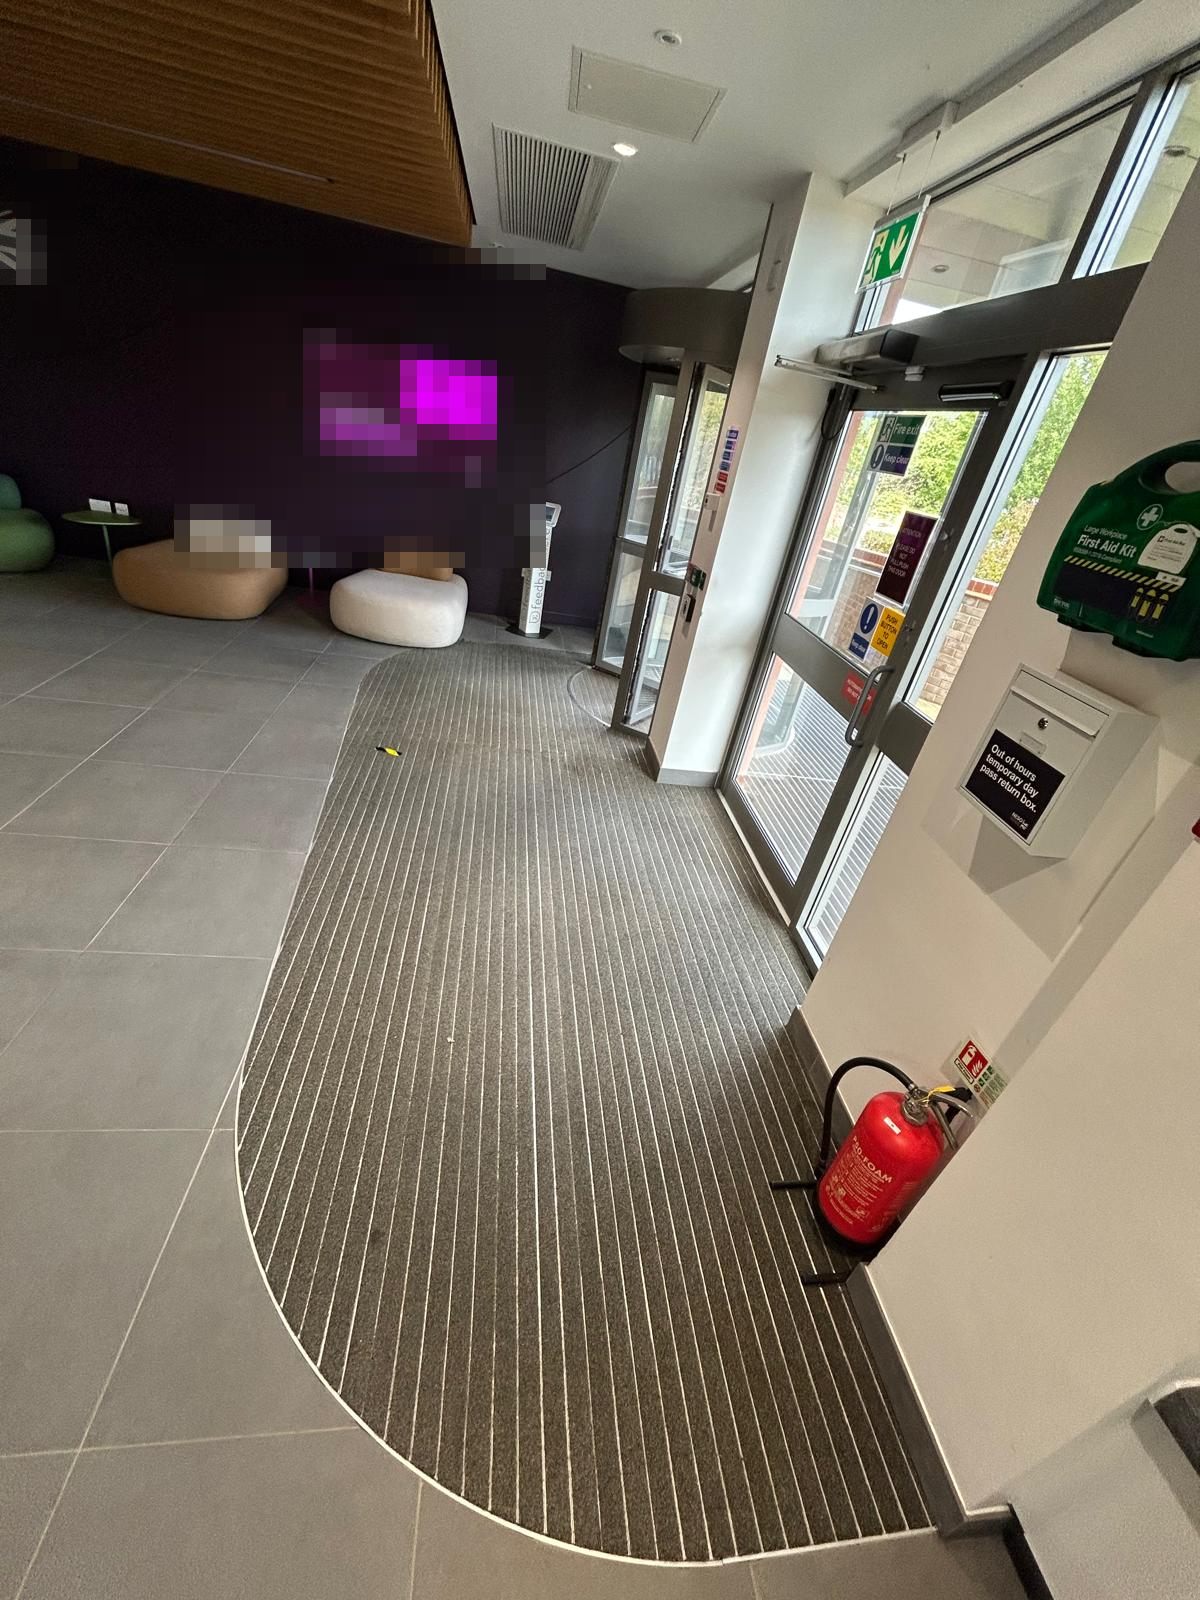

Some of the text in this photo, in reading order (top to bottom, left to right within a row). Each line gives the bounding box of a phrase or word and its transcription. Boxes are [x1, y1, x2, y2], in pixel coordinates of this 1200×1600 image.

[894, 421, 920, 434] Fire exit
[884, 455, 896, 465] Keep
[1077, 534, 1101, 549] First
[1099, 540, 1121, 554] Aid
[1119, 543, 1137, 558] Kit
[887, 614, 898, 624] PUSH
[880, 620, 897, 635] BUTTON
[882, 631, 889, 640] TO
[877, 639, 888, 649] OPEN
[991, 744, 1036, 782] Out of hours
[986, 753, 1039, 798] temporary day
[980, 764, 1037, 813] pass return box.
